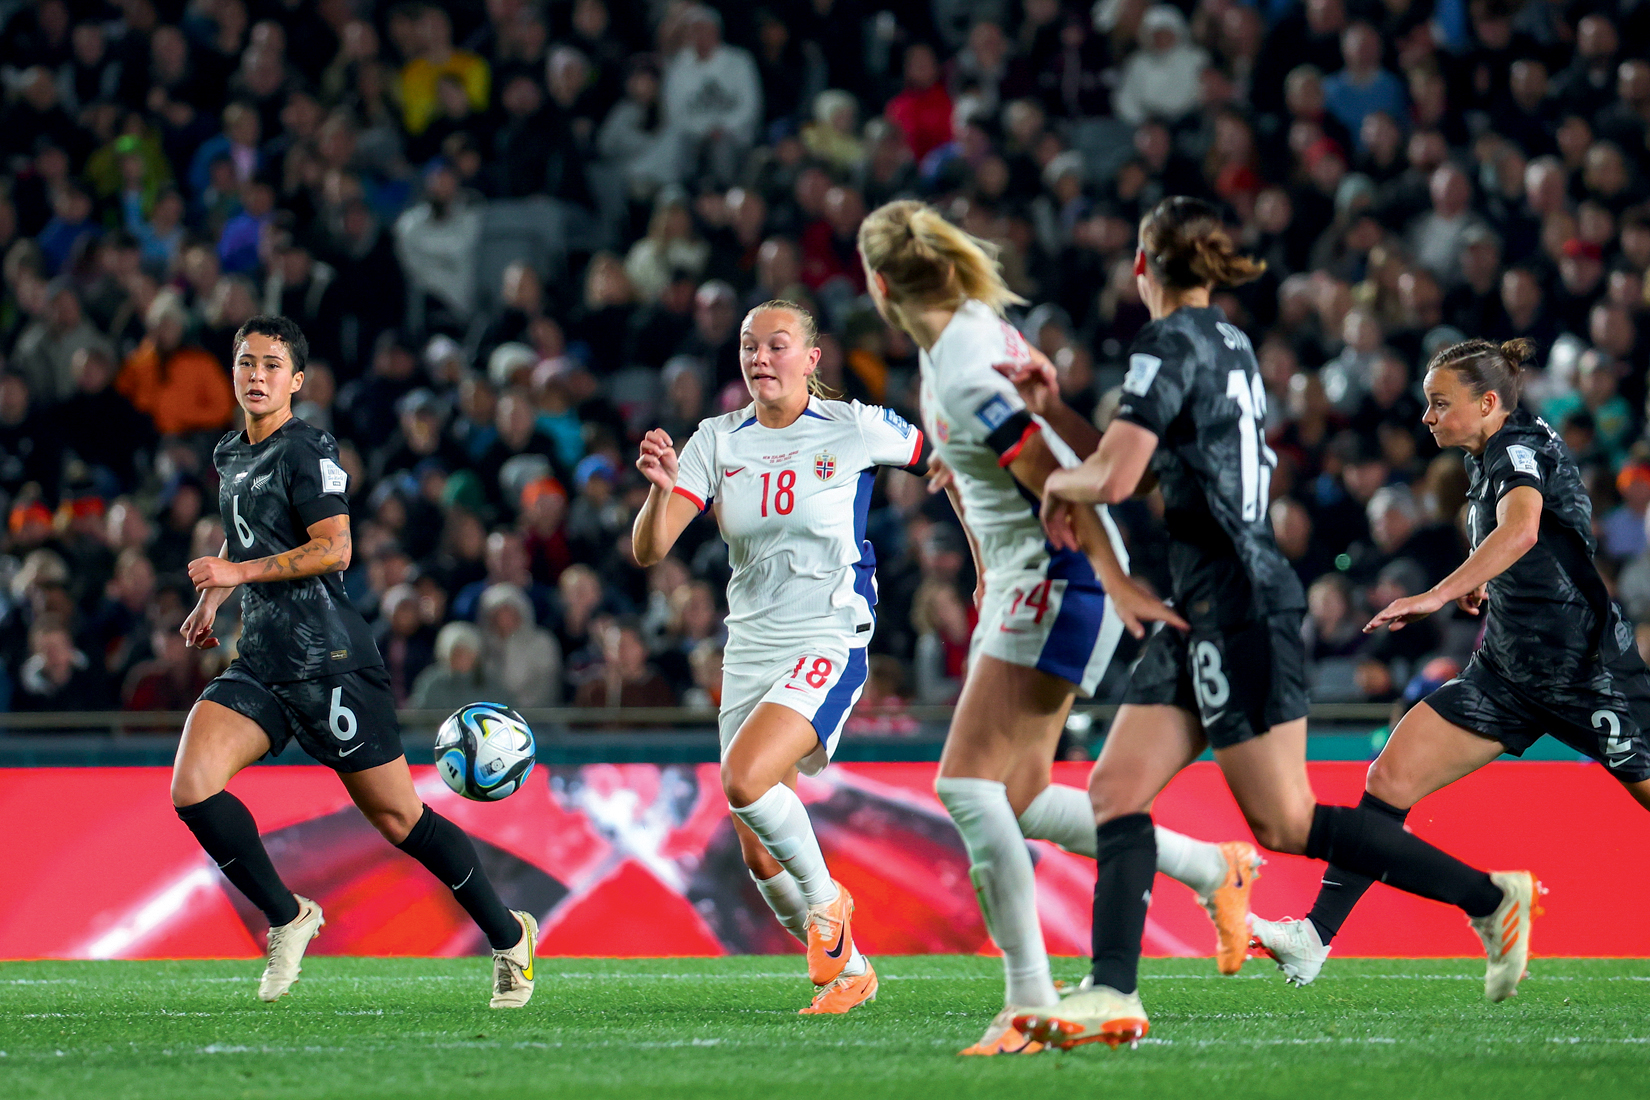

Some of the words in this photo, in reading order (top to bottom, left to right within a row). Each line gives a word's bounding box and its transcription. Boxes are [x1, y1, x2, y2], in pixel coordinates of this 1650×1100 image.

[760, 469, 796, 517] 18
[233, 494, 255, 549] 6
[1010, 579, 1052, 625] 14
[790, 656, 832, 689] 18
[1188, 640, 1231, 709] 13
[329, 685, 358, 741] 6
[1591, 709, 1632, 754] 2
